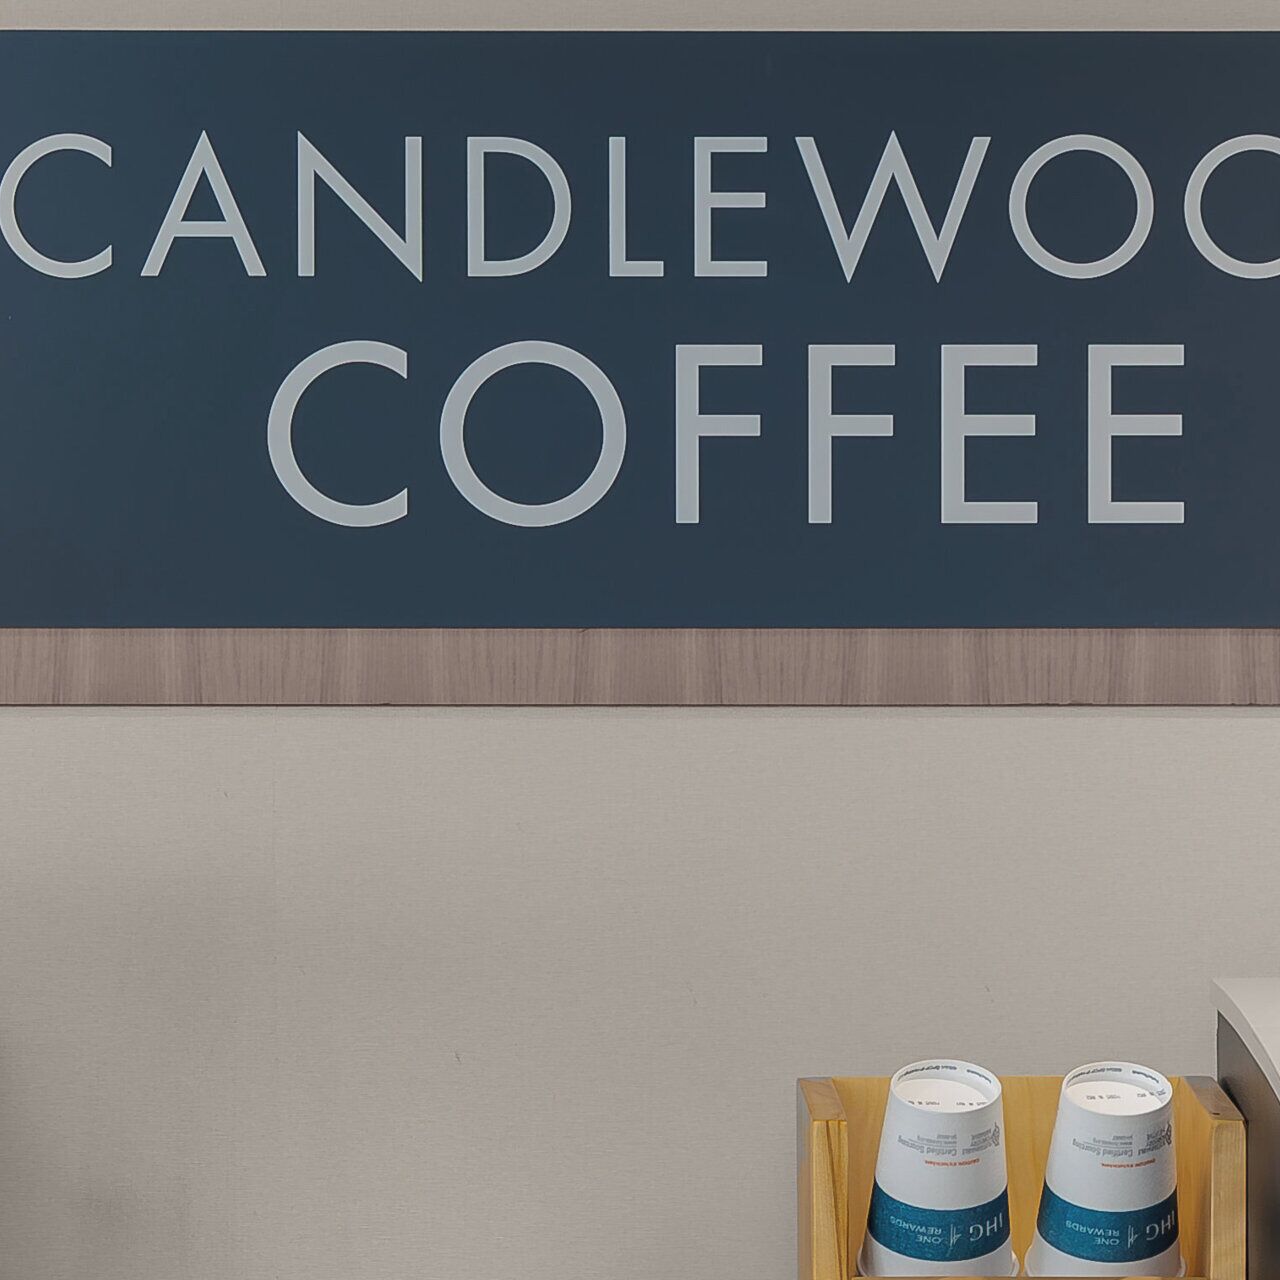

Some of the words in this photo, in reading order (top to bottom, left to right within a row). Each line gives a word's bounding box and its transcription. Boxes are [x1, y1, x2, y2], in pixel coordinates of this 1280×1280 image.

[266, 339, 1185, 528] COFFEE
[890, 1215, 942, 1234] REWARDS
[969, 1213, 1003, 1241] IHG
[1066, 1220, 1119, 1237] REWARDS
[1146, 1210, 1175, 1239] IHG
[916, 1234, 942, 1244] ONE
[1094, 1237, 1119, 1246] ONE
